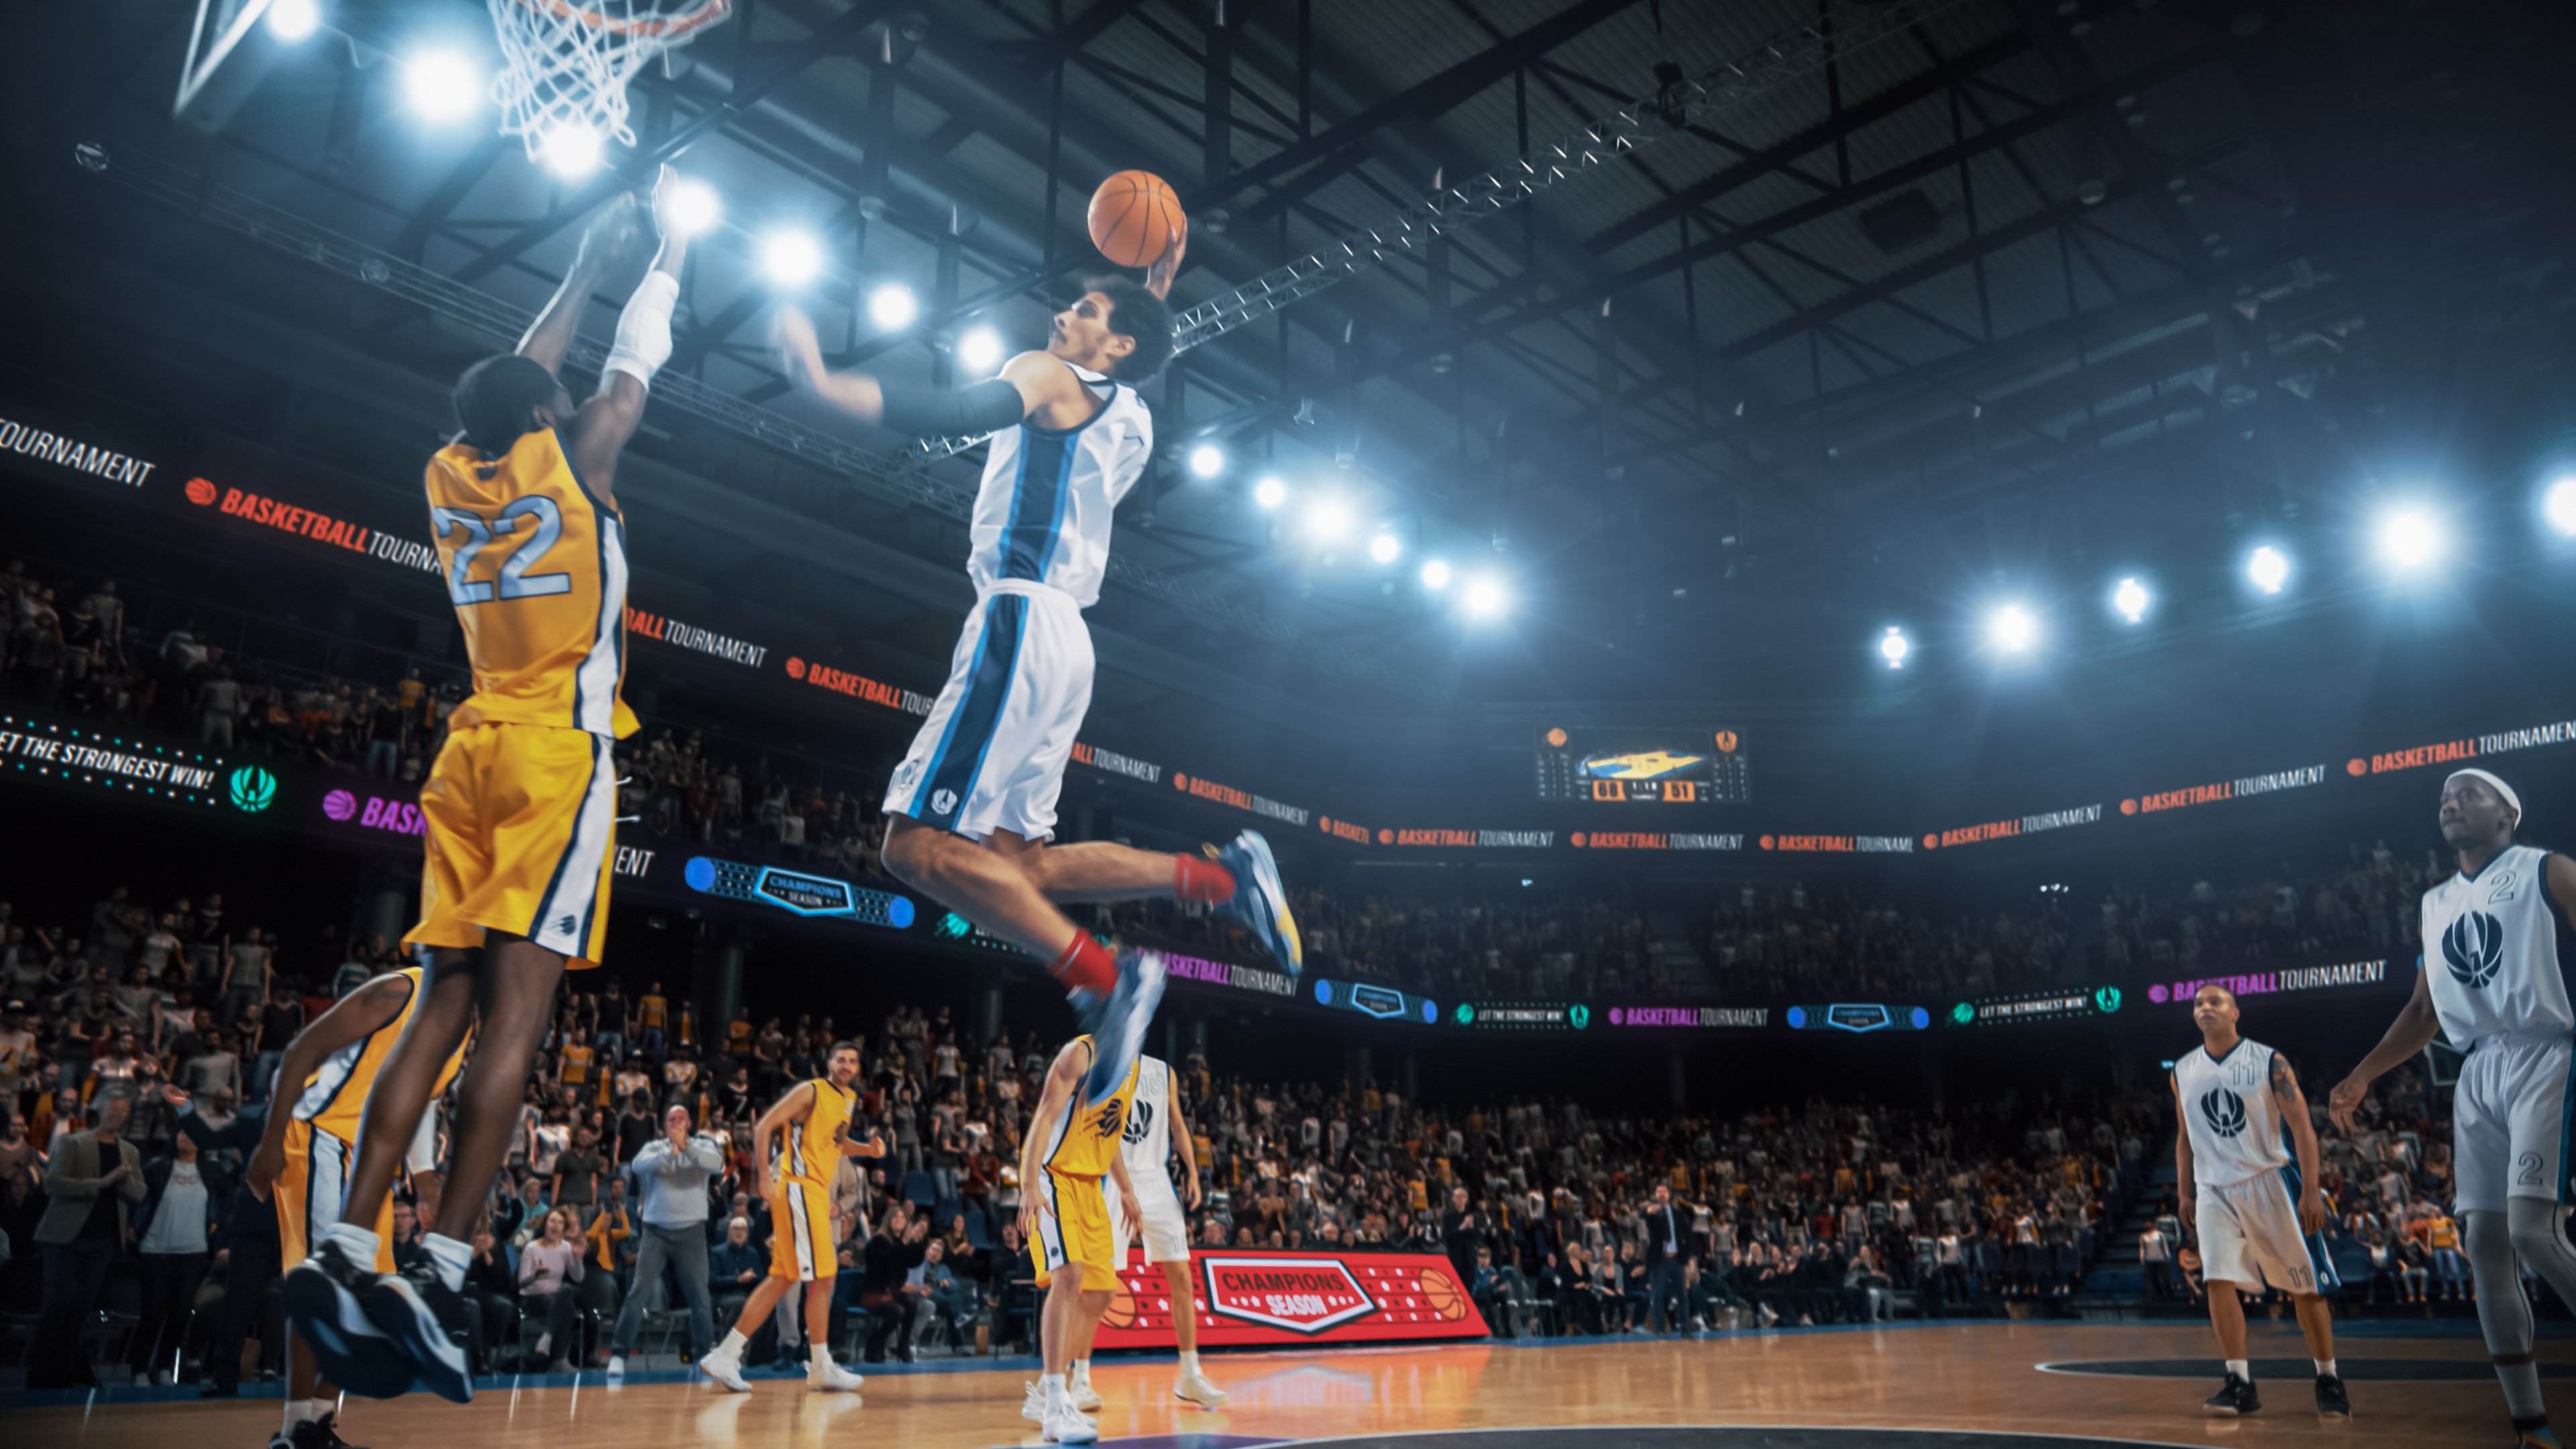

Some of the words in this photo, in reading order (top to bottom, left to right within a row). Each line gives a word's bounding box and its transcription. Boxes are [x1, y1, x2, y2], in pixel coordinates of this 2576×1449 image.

[433, 494, 572, 605] 22
[21, 735, 63, 761] THE
[60, 743, 170, 782] STRONGEST
[169, 763, 215, 790] WIN!
[769, 875, 842, 899] CHAMPIONS
[788, 891, 823, 907] SEASON
[2488, 872, 2516, 904] 2
[2229, 1060, 2255, 1086] 11
[2517, 1151, 2543, 1187] 2
[1222, 1272, 1345, 1292] CHAMPIONS
[2287, 1265, 2314, 1288] 11
[1265, 1295, 1328, 1316] SEASON
